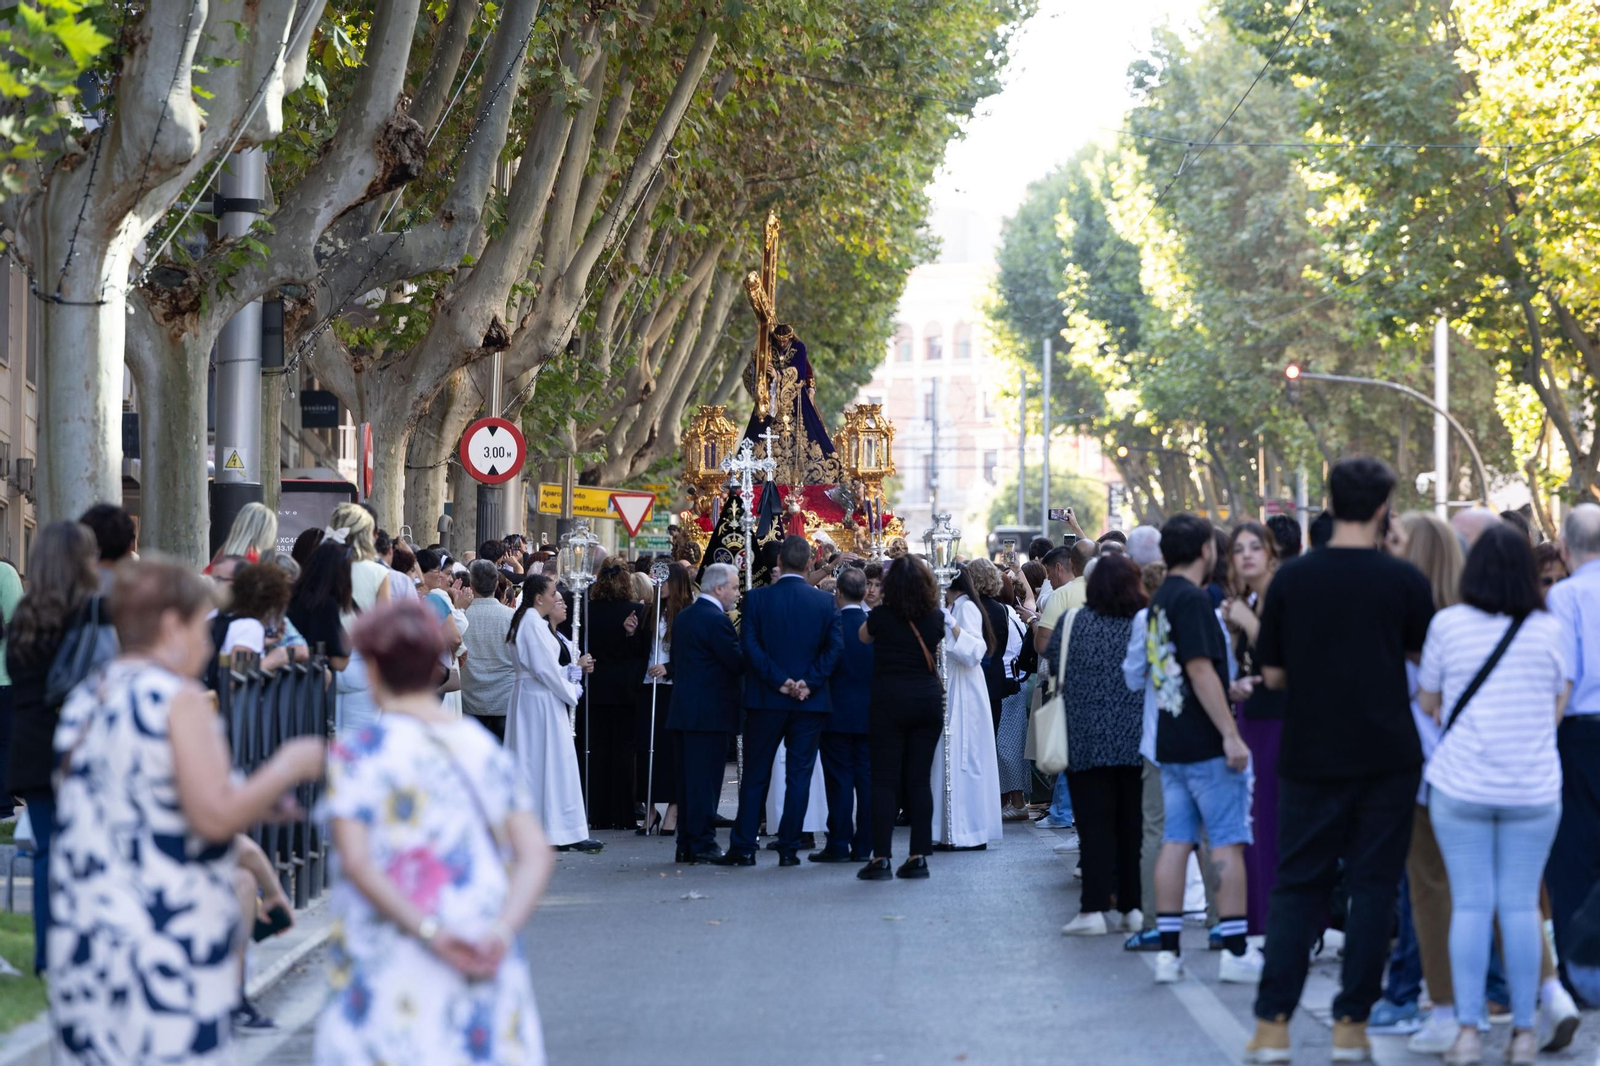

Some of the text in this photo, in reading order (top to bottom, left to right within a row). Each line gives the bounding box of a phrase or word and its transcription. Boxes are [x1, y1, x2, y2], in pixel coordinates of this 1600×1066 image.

[483, 446, 505, 459] 3,00
[542, 489, 586, 500] Aparcnto
[572, 504, 607, 513] nstitución
